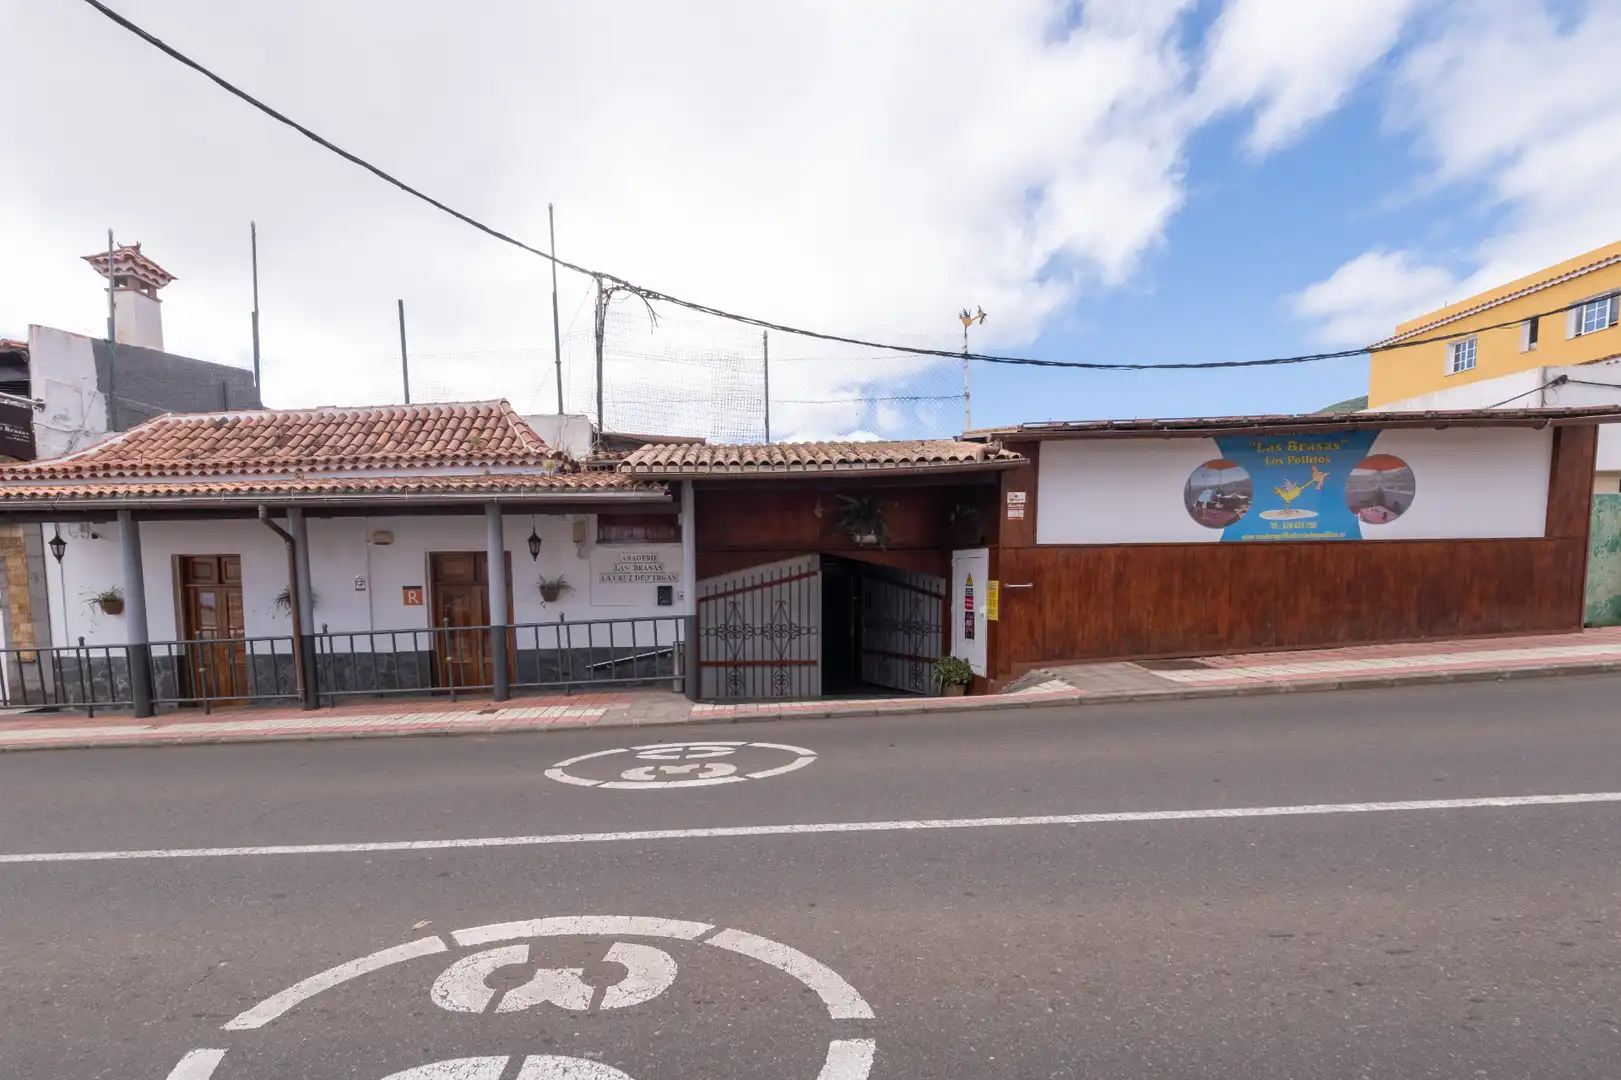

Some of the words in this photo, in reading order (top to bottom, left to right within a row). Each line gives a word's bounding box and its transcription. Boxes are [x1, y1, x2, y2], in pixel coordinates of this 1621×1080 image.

[1264, 456, 1284, 466] Los
[613, 564, 629, 572] LAS
[601, 574, 612, 582] LA
[635, 574, 645, 582] DE
[408, 590, 420, 604] R
